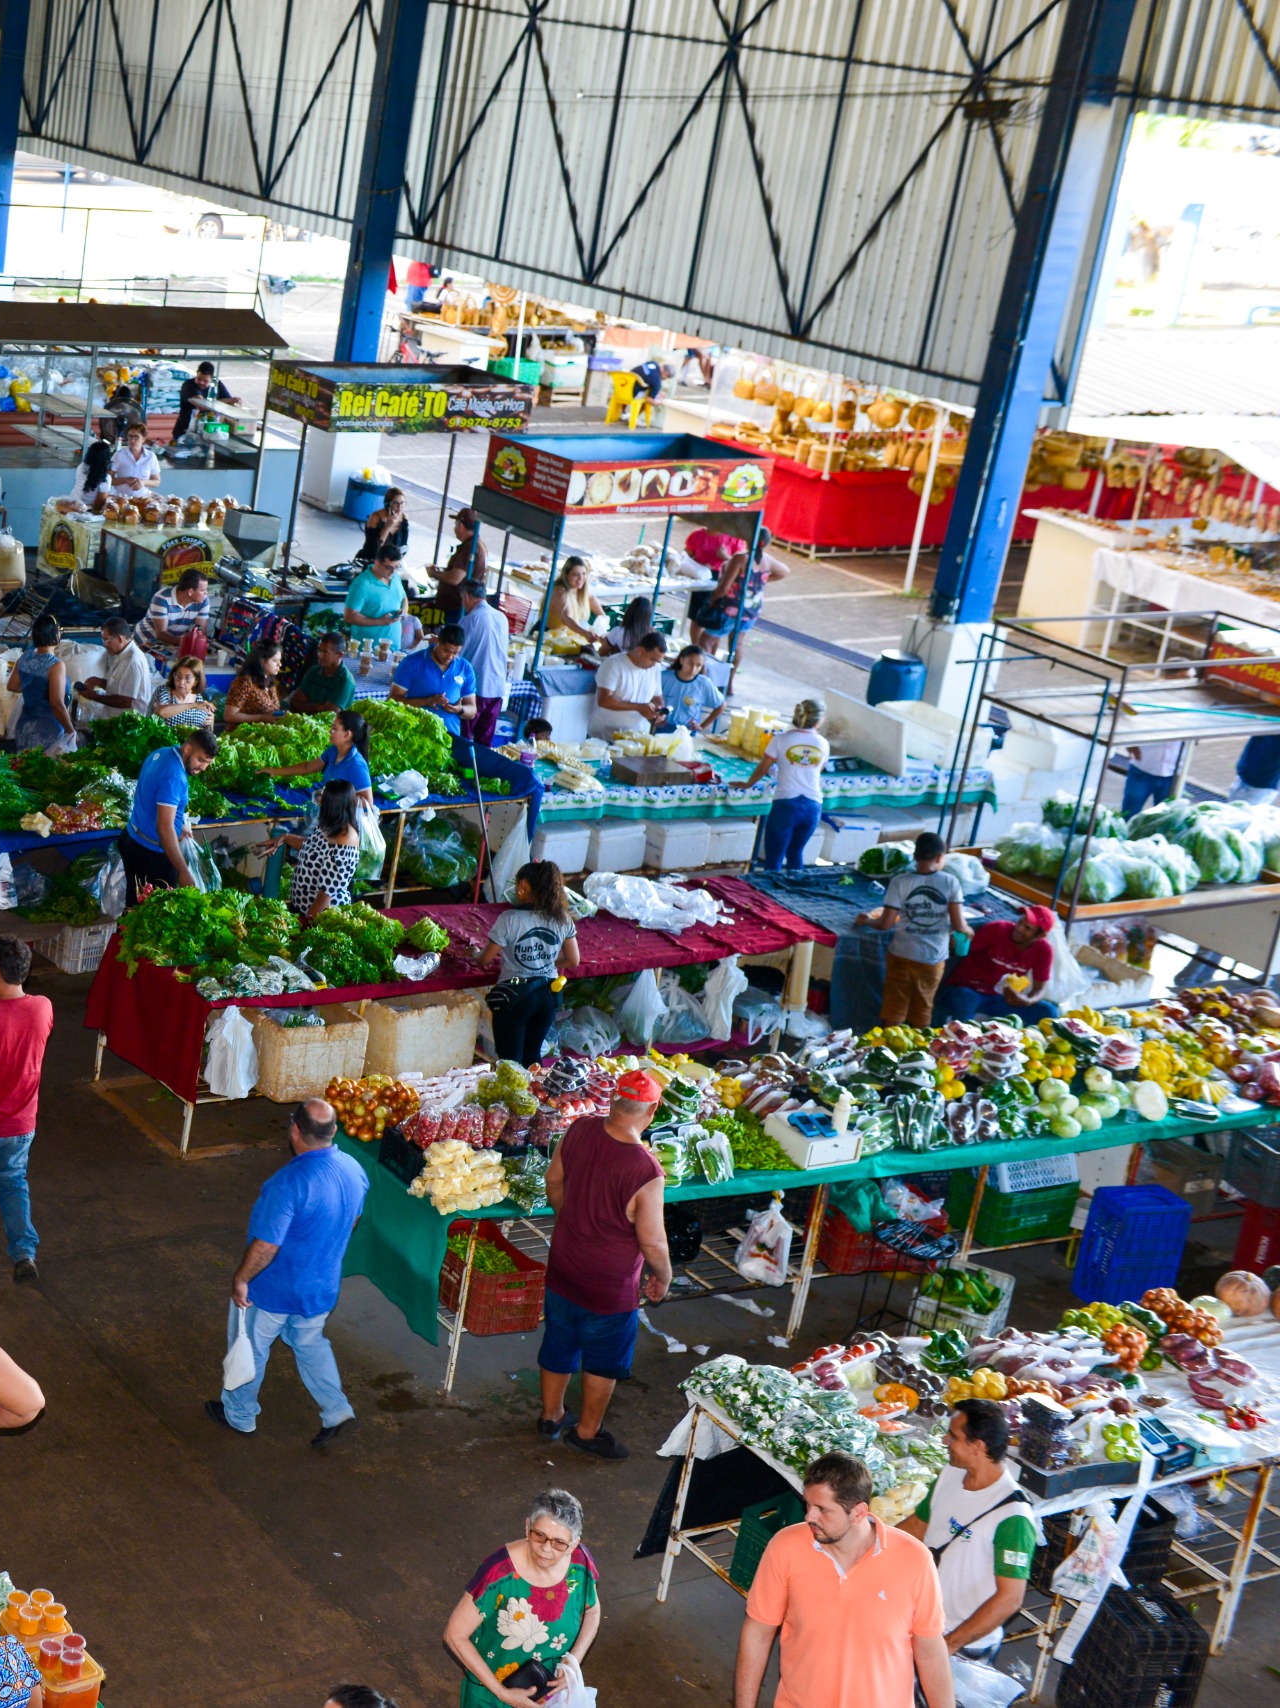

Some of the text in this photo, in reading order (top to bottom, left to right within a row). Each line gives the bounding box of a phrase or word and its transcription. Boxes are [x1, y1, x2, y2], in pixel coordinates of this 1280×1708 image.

[272, 368, 287, 387] Rei
[307, 381, 319, 399] TO
[339, 390, 373, 417] Rei
[374, 389, 420, 418] Café
[423, 390, 448, 418] TO
[447, 397, 468, 412] Café
[495, 401, 505, 412] na
[506, 398, 525, 412] Hora
[448, 417, 522, 429] 9 9976-8753
[162, 536, 179, 550] Pães
[905, 900, 932, 911] Mundo
[514, 942, 544, 953] Mundo
